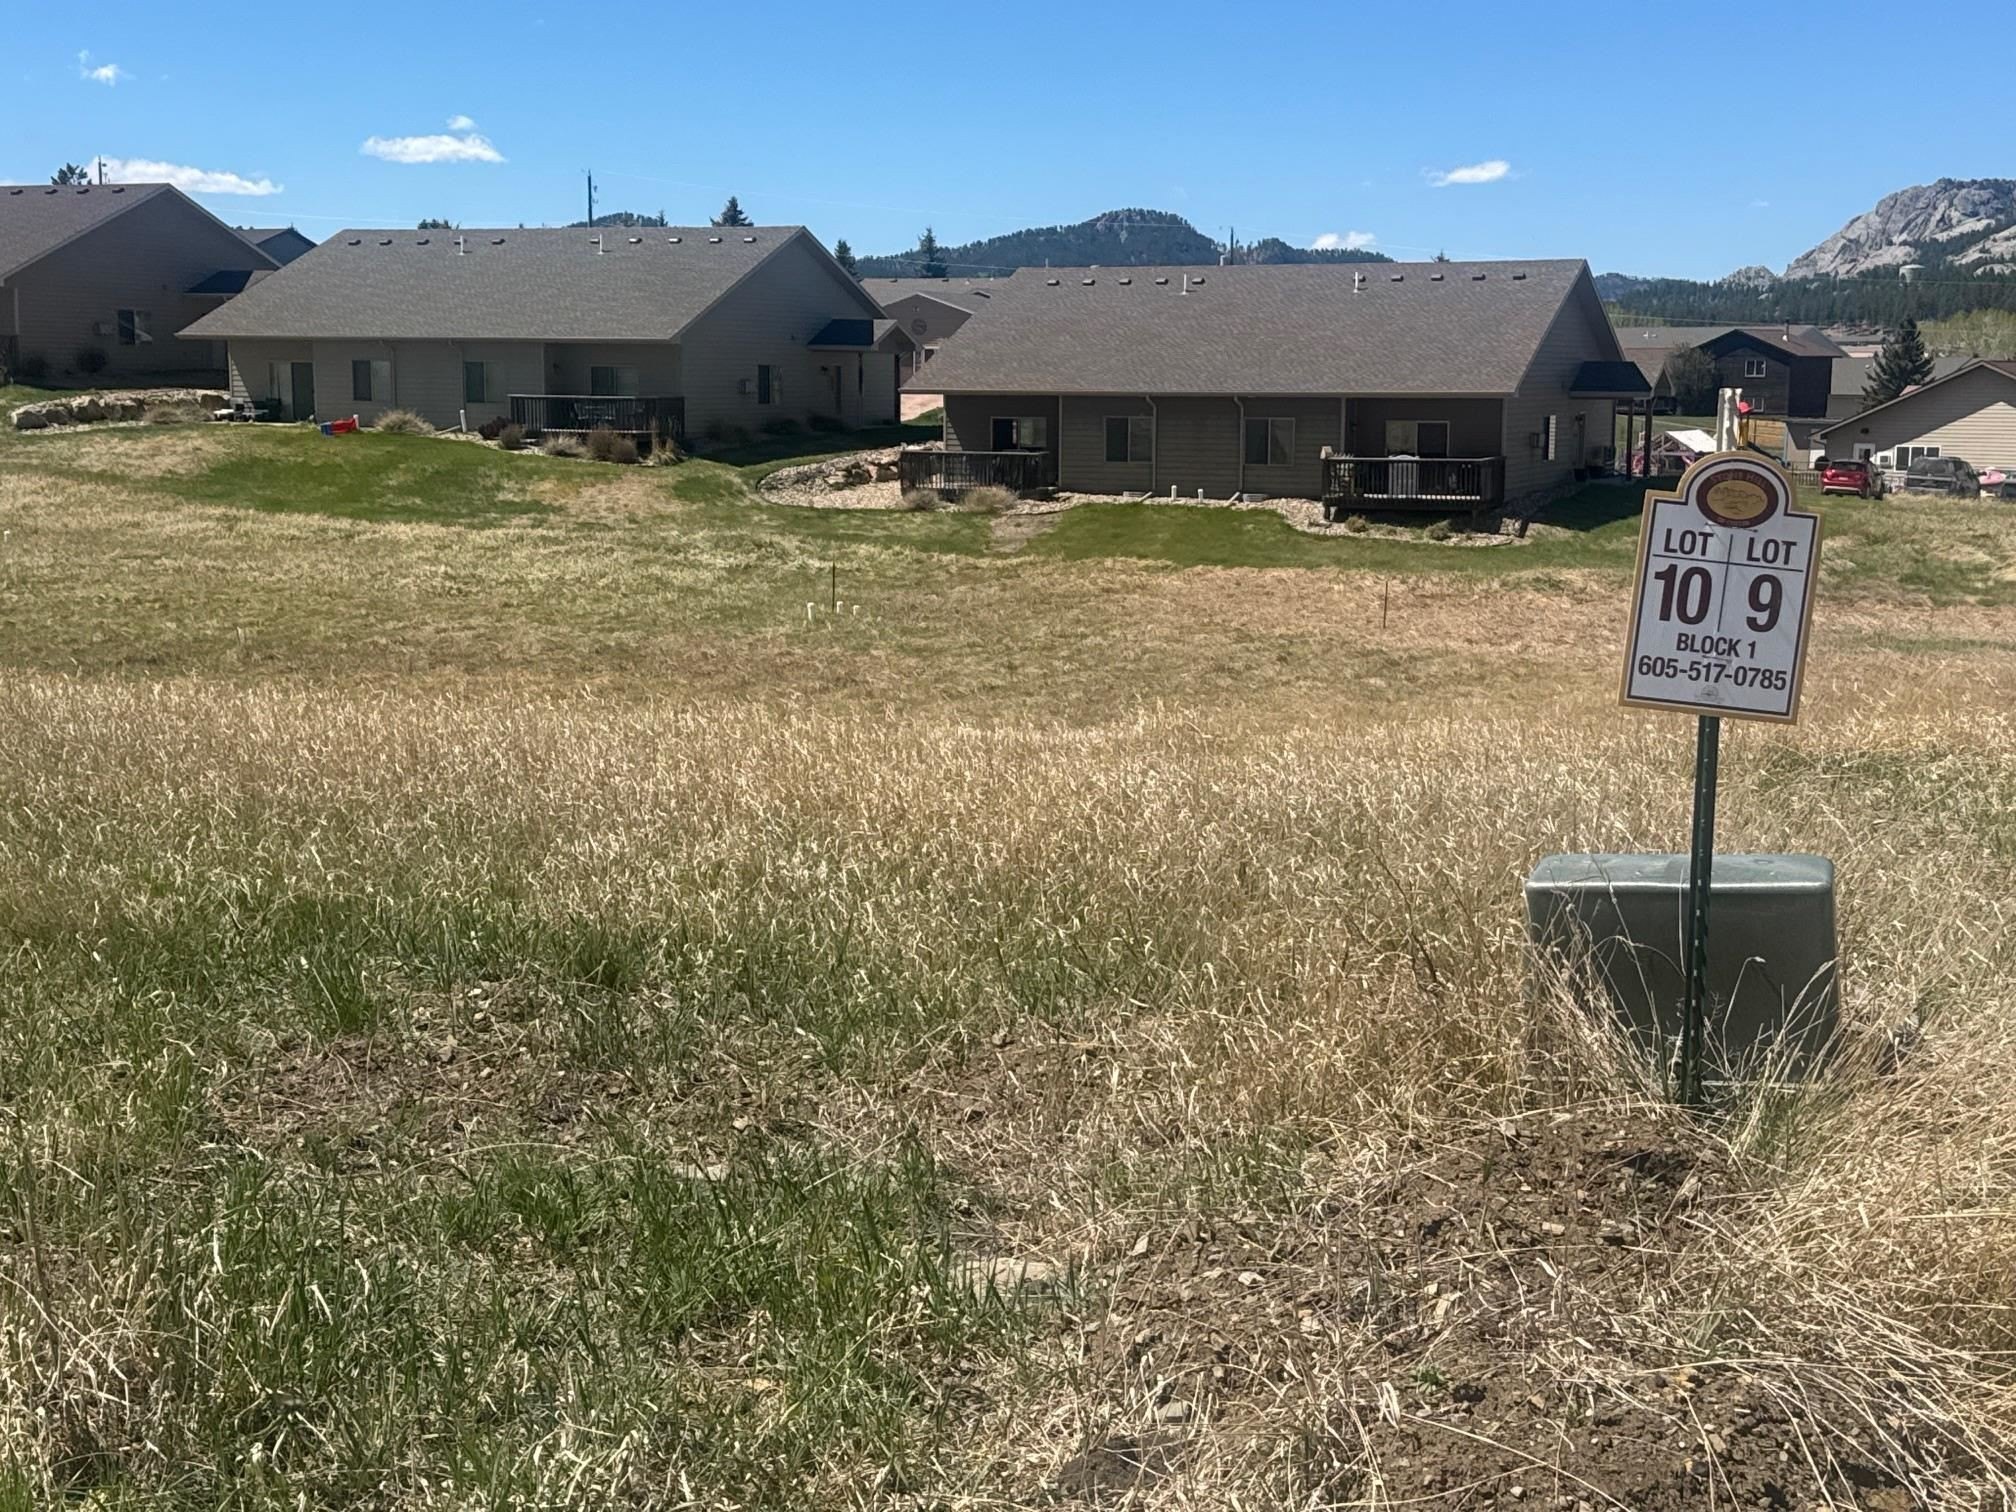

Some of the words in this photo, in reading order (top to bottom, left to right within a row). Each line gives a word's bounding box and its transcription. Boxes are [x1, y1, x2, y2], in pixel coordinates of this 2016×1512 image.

[1664, 528, 1714, 556] LOT
[1747, 537, 1797, 565] LOT
[1654, 563, 1713, 625] 10
[1746, 574, 1783, 633] 9
[1676, 632, 1741, 658] BLOCK
[1748, 640, 1756, 659] 1
[1638, 655, 1787, 691] 605-517-0785
